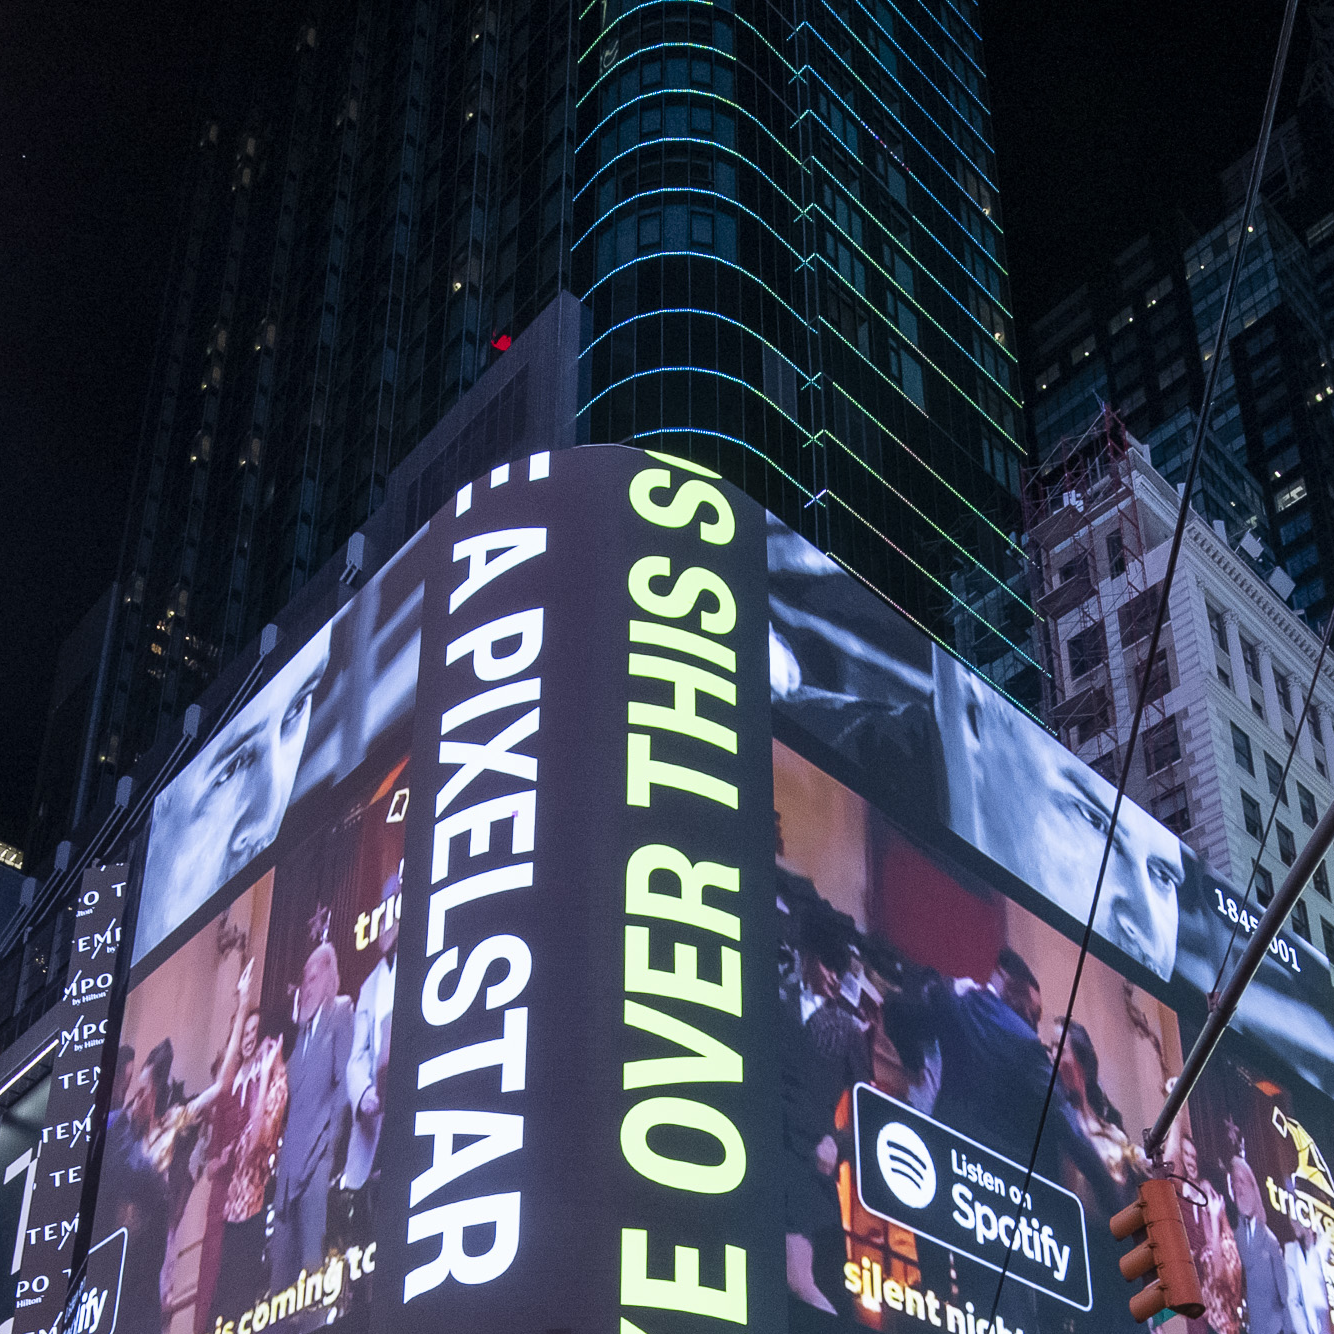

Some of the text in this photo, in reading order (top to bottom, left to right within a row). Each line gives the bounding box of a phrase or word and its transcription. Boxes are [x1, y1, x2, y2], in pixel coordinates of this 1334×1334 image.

[450, 526, 547, 614] A
[626, 555, 739, 810] THIS
[404, 607, 544, 1304] PIXELSTAR
[619, 843, 746, 1194] OVER
[951, 1149, 1032, 1210] Listen on
[952, 1182, 1070, 1281] Spotify
[844, 1256, 941, 1327] silent
